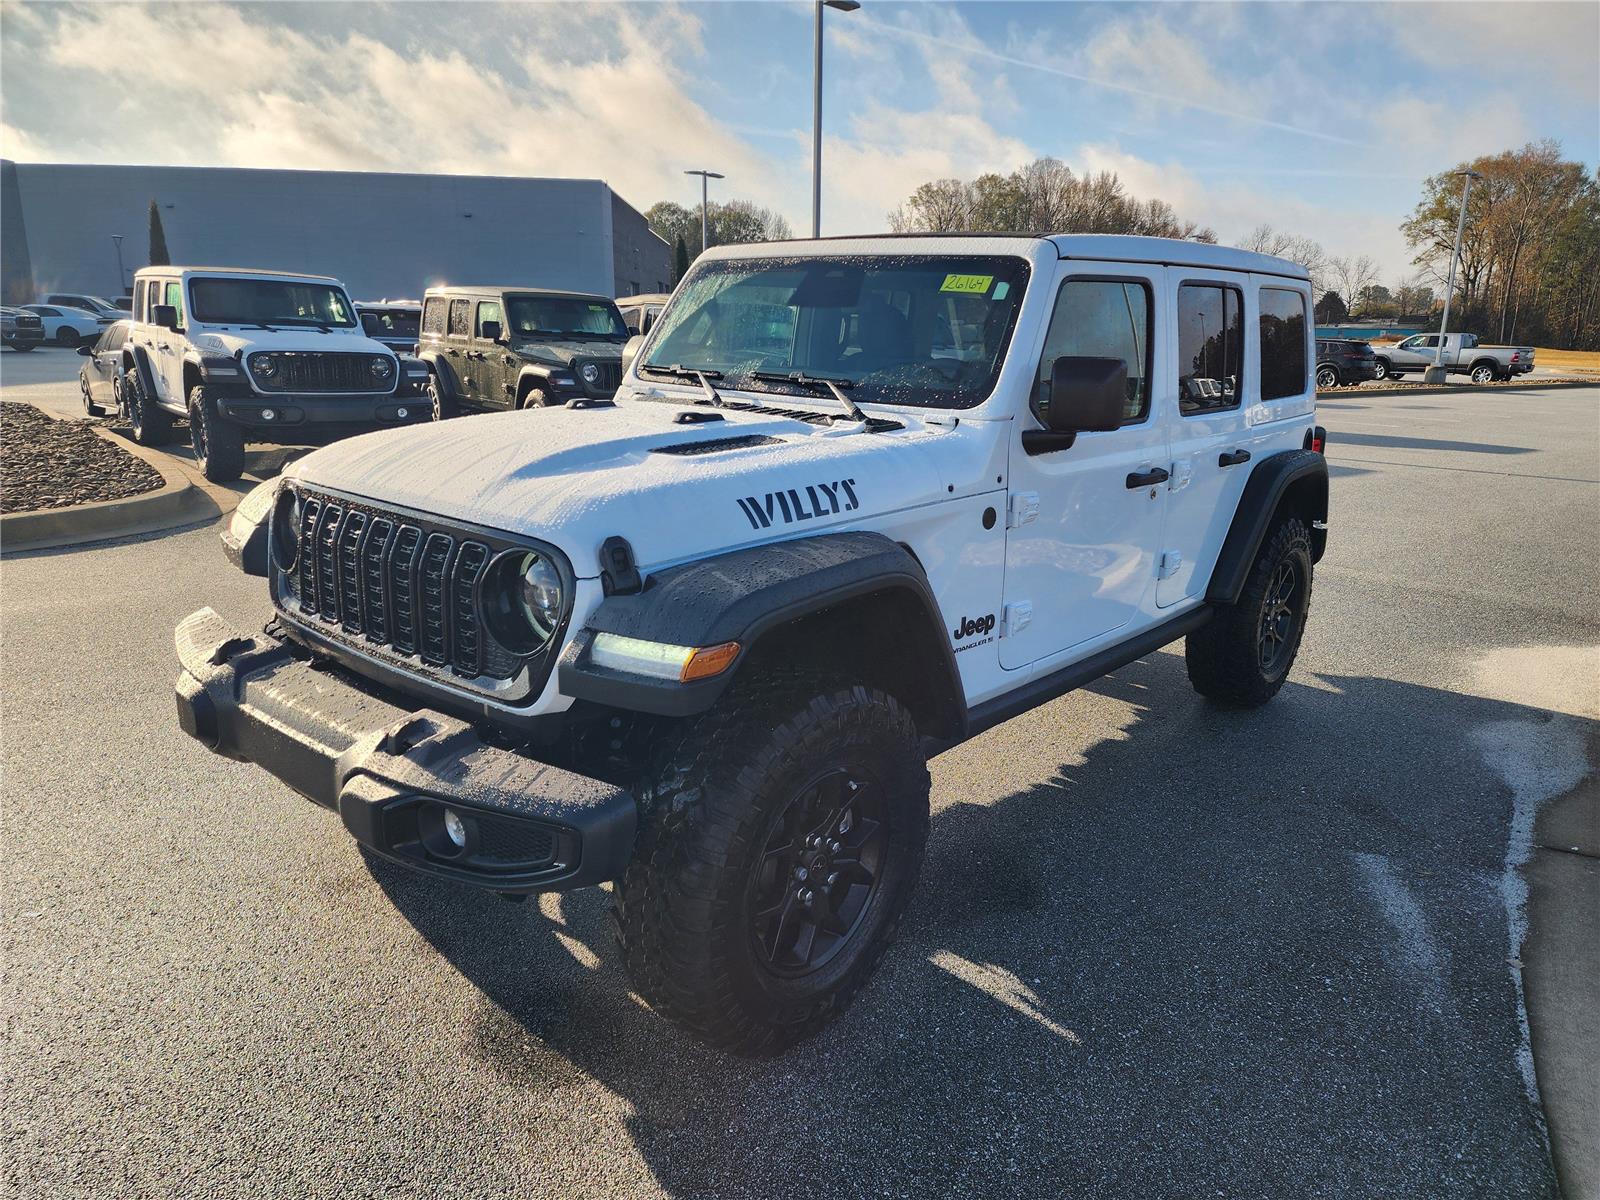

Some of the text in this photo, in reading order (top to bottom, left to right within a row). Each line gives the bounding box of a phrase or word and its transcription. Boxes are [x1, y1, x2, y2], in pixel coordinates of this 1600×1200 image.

[945, 275, 984, 290] 26164
[736, 478, 859, 530] WILLYS
[953, 613, 996, 640] Jeep
